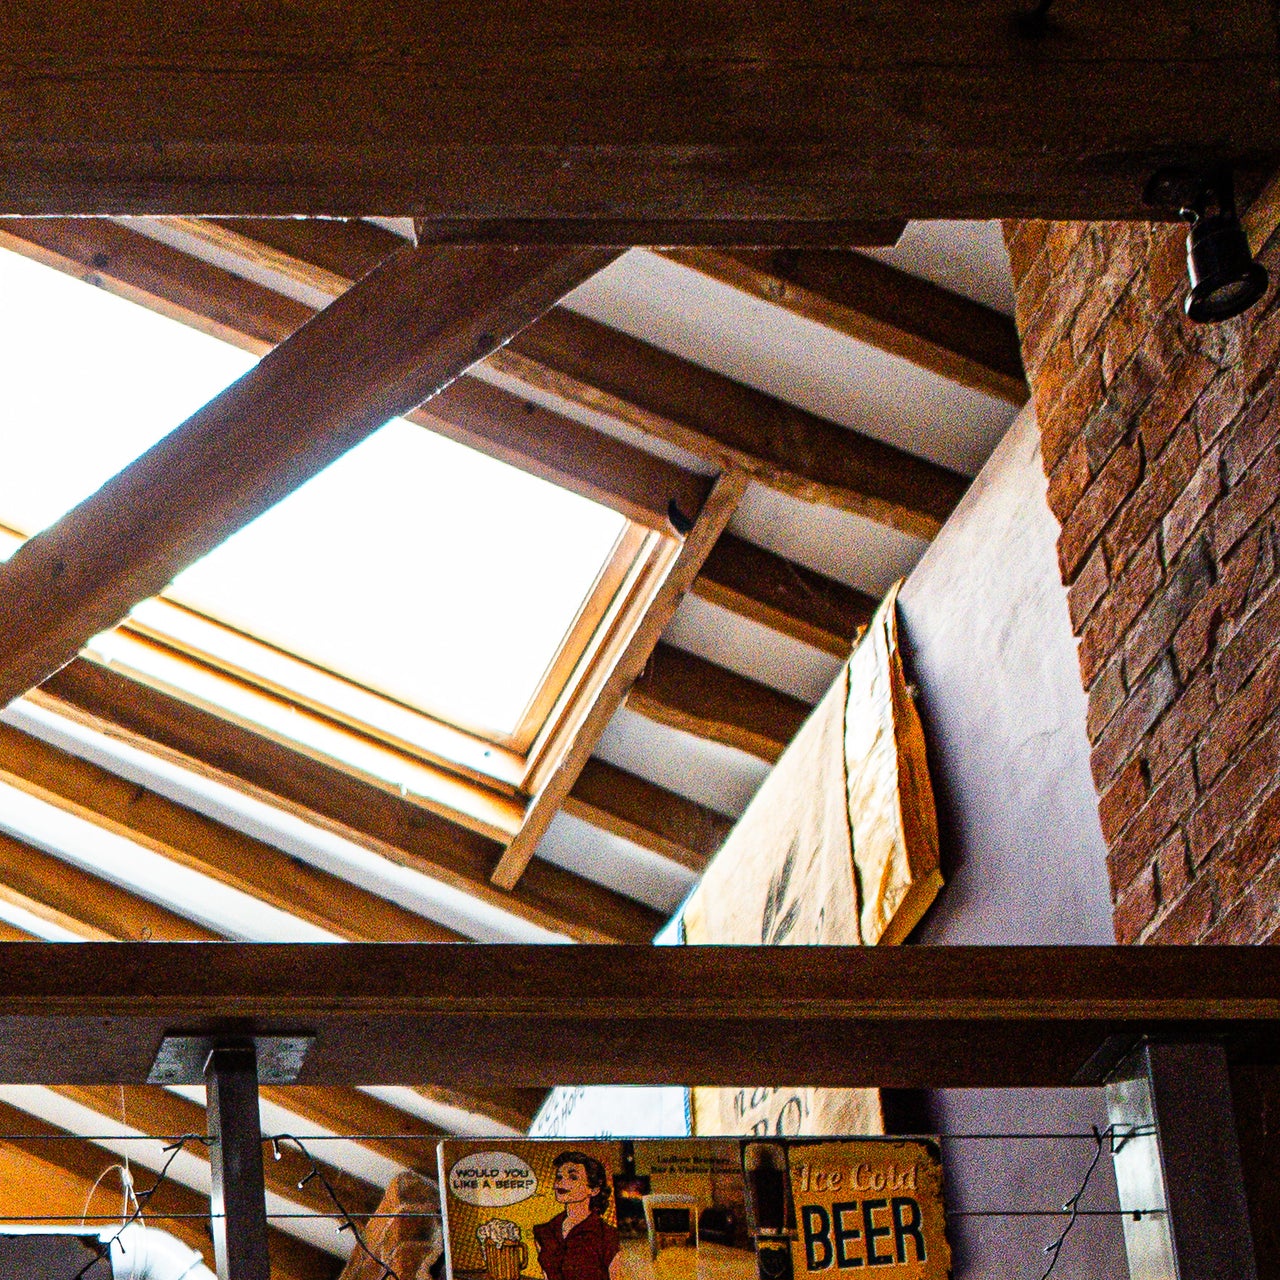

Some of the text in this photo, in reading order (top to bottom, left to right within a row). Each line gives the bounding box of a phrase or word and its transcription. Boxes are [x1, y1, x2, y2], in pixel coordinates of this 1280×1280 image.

[455, 1168, 529, 1178] WOULD YOU
[800, 1162, 918, 1192] Ice Cold
[453, 1179, 535, 1190] LIKE A BEER?
[802, 1197, 928, 1274] BEER
